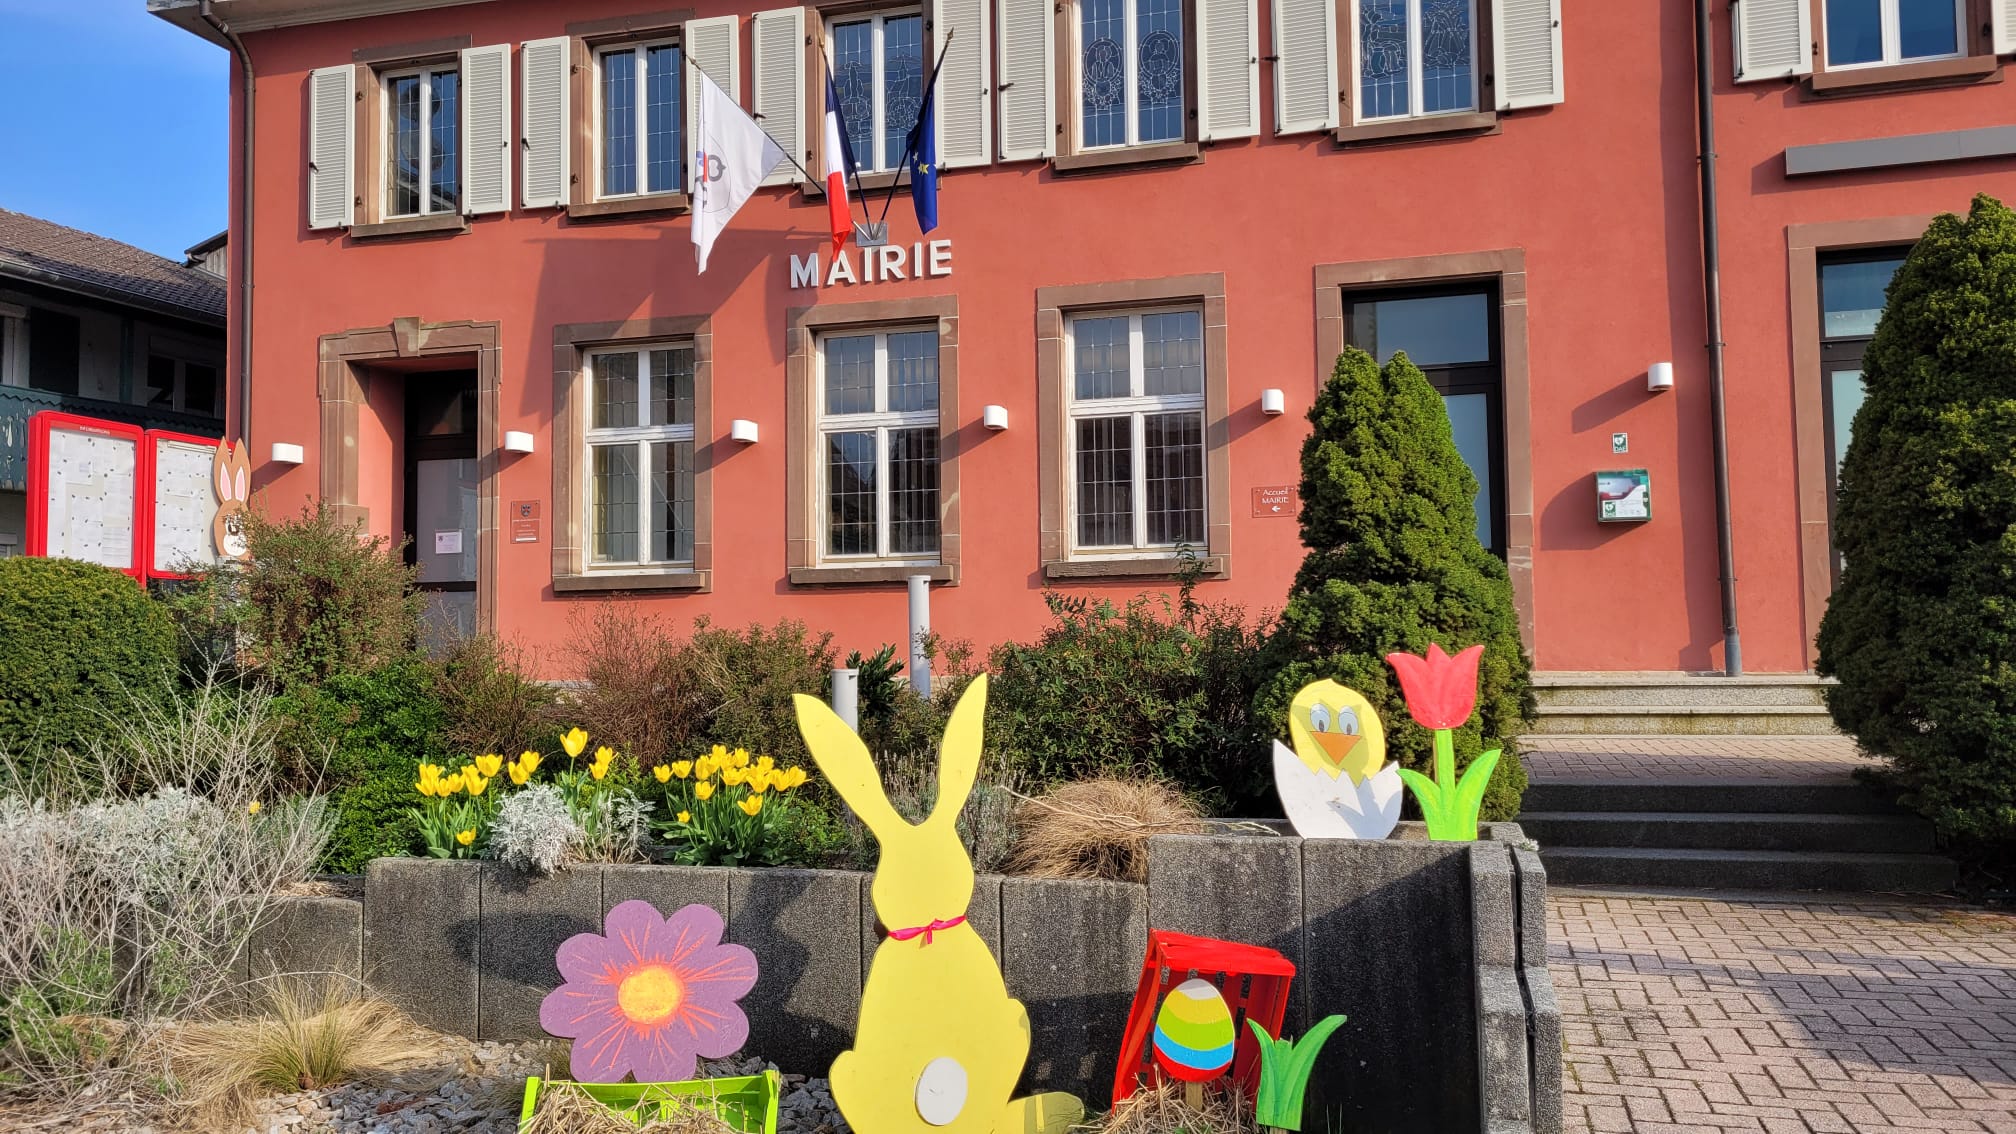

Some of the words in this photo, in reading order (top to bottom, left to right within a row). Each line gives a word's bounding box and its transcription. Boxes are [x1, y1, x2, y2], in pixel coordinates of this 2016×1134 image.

[790, 239, 952, 289] MAIRIE
[1262, 485, 1288, 496] Accueil
[1261, 496, 1289, 504] MAIRIE
